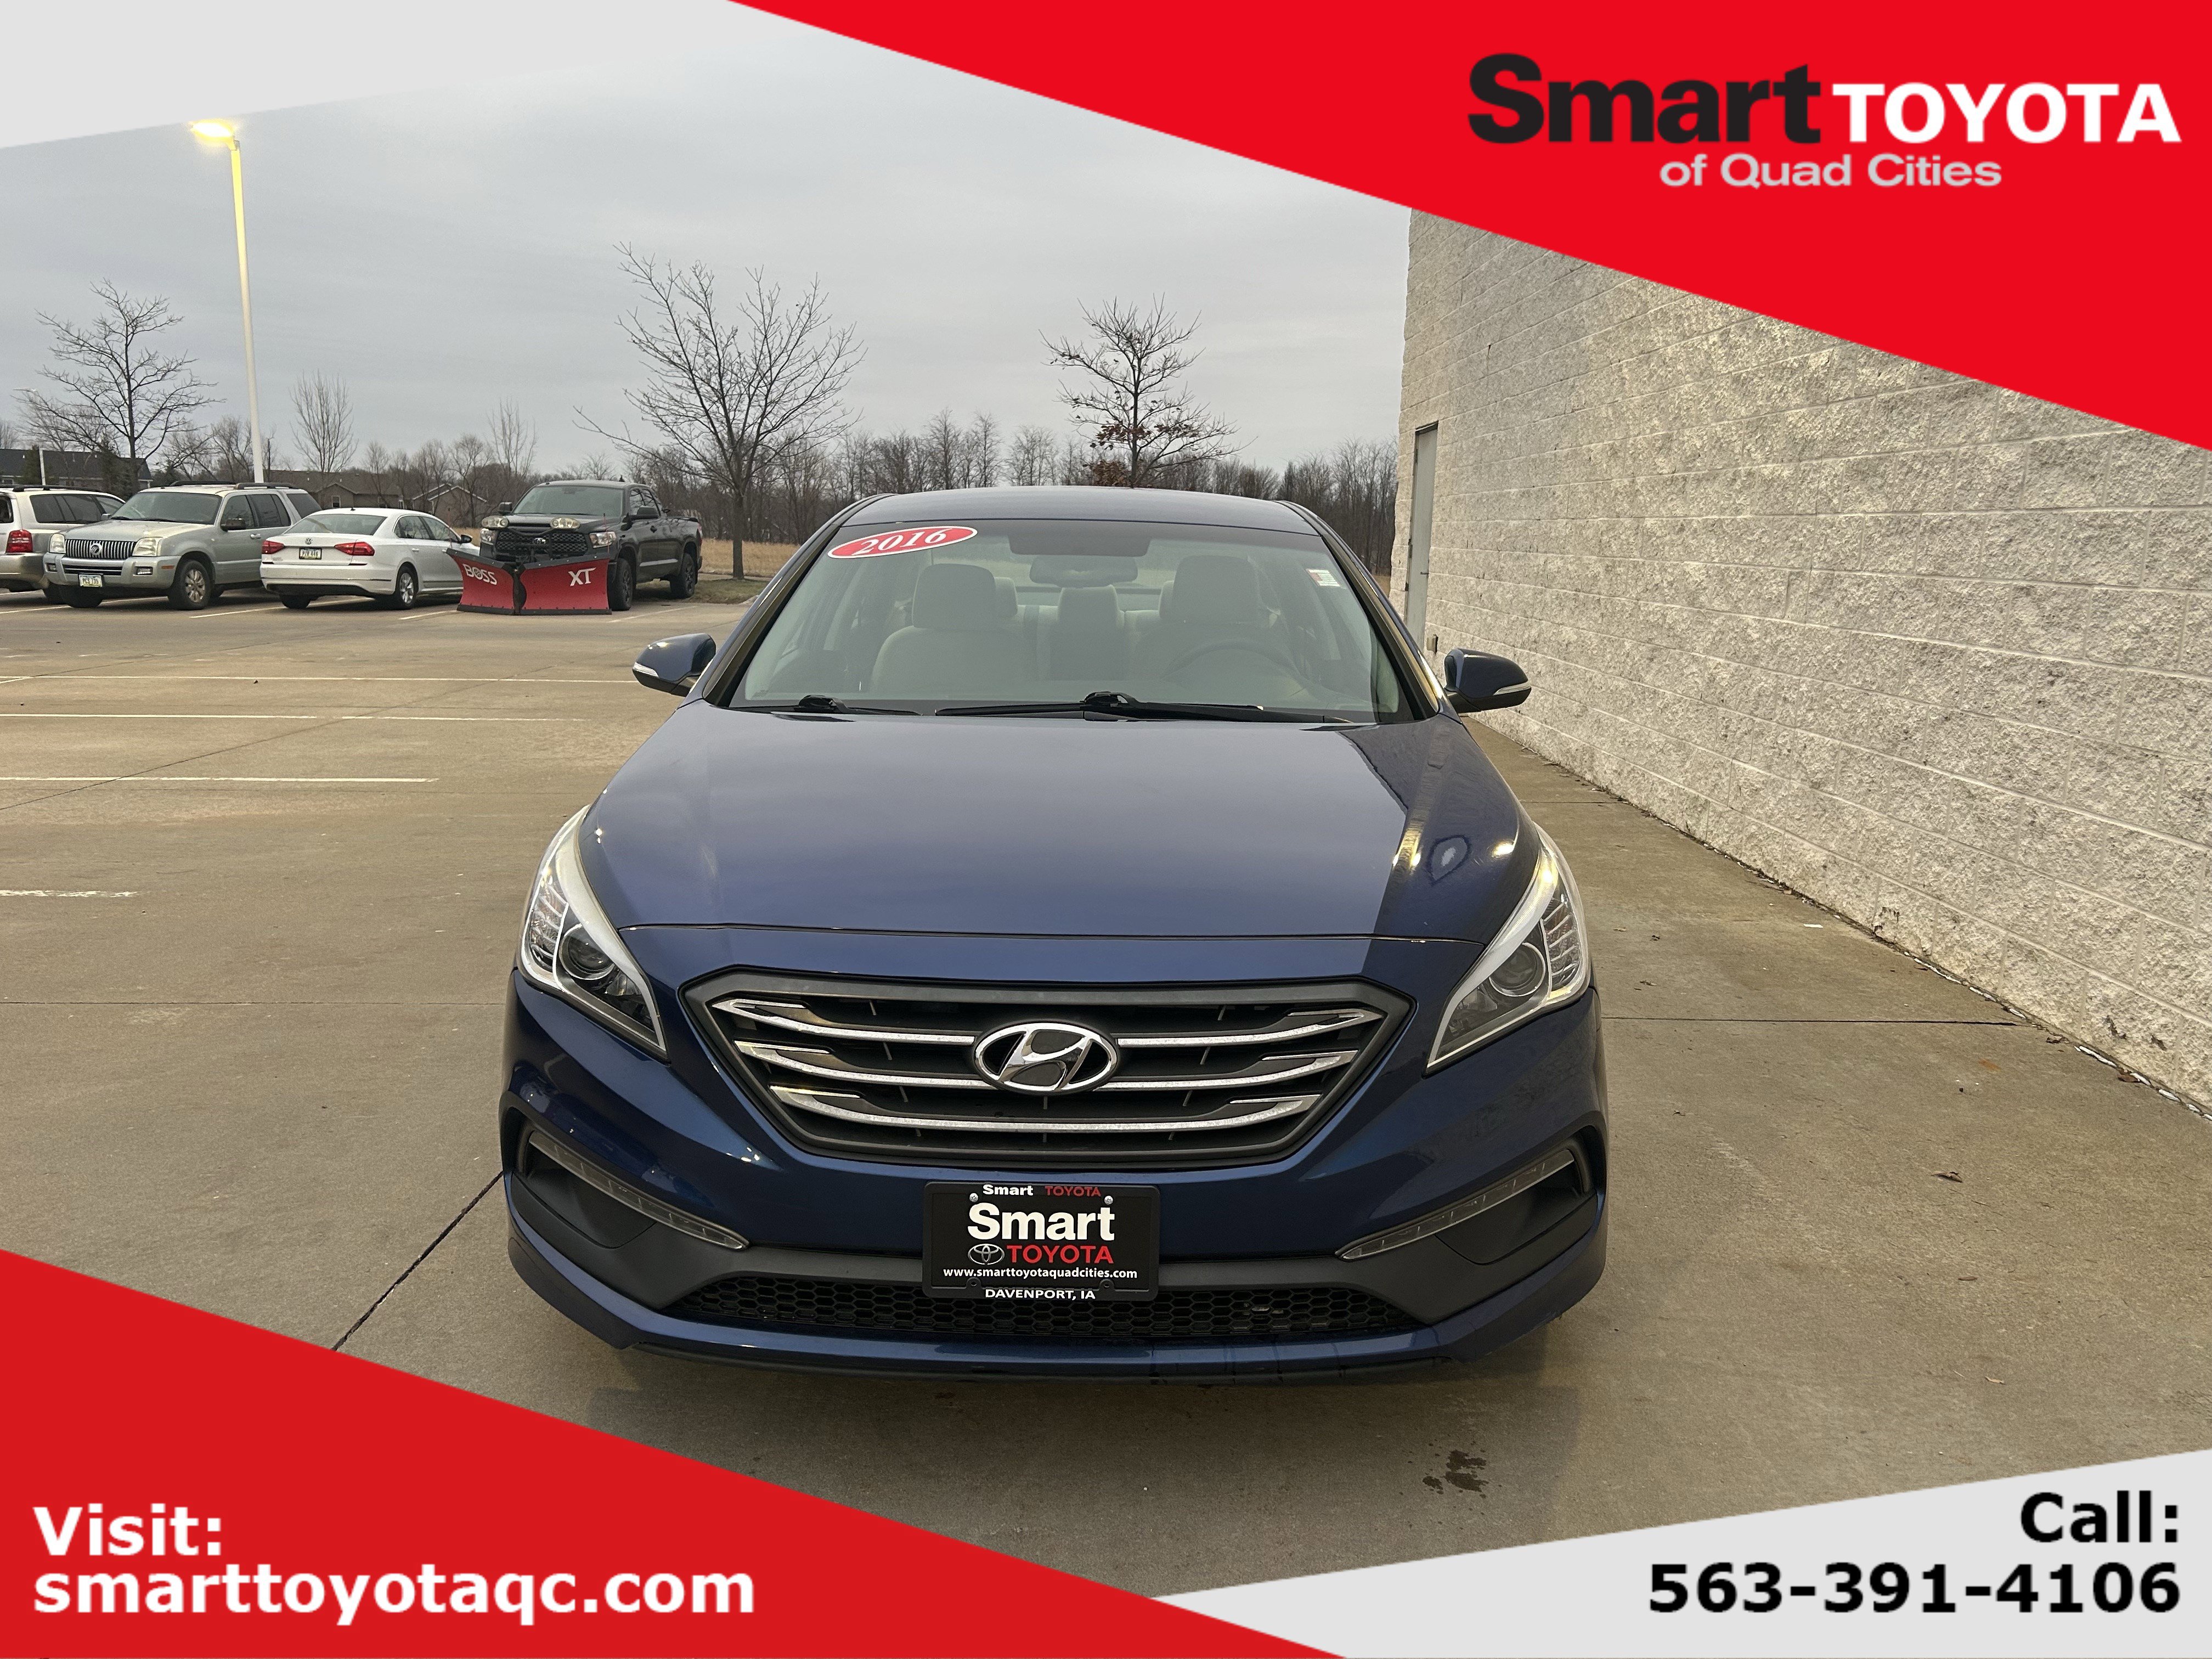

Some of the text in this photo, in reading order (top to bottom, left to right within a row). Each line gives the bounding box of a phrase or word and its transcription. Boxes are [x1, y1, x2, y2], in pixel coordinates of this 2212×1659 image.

[851, 528, 952, 556] 2016
[462, 563, 497, 585] BOSS
[568, 567, 596, 586] XT
[983, 1184, 1101, 1197] Smart TOYOTA
[967, 1202, 1115, 1241] Smart
[1007, 1244, 1114, 1264] TOYOTA
[943, 1266, 1137, 1279] www.smarttoyotaquadcities.com
[985, 1289, 1096, 1301] DAVENPORT, IA
